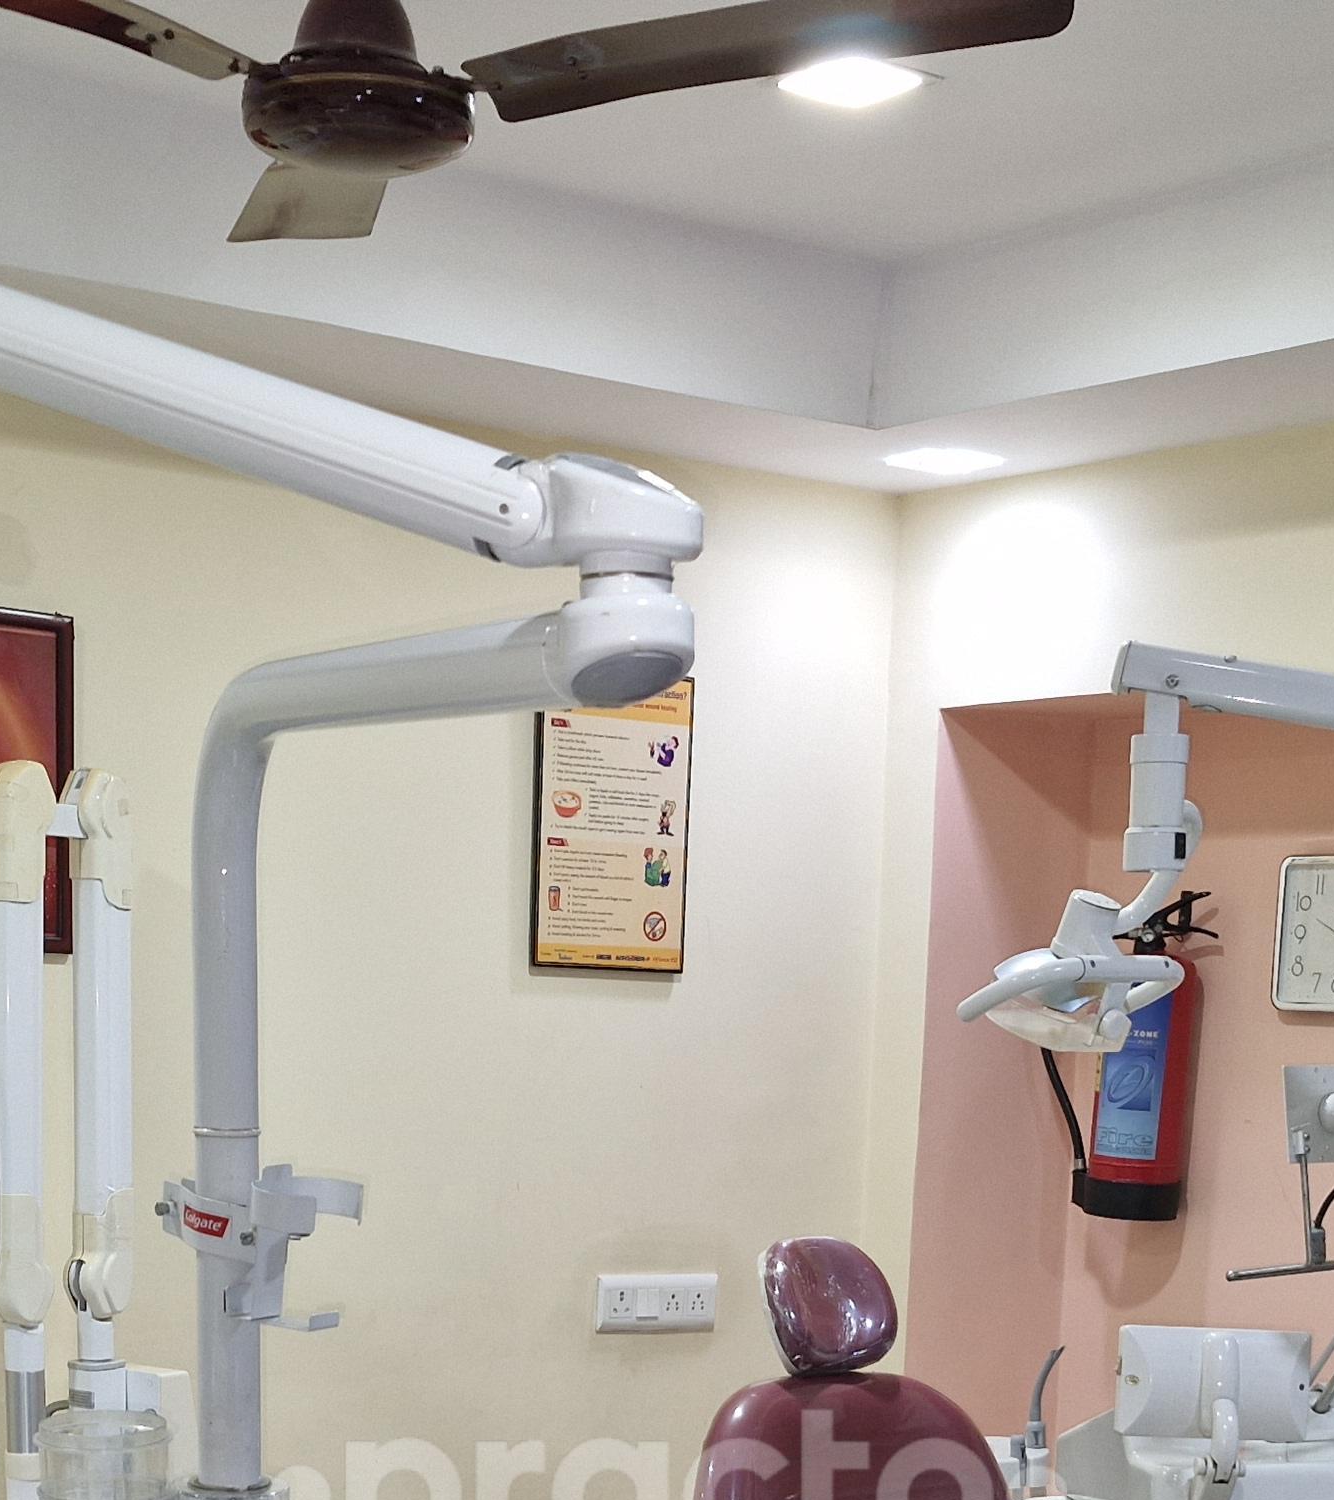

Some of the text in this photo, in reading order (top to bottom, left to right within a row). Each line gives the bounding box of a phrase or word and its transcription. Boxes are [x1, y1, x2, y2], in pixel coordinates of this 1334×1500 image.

[1295, 891, 1312, 912] 10
[1294, 924, 1307, 944] 9
[1291, 955, 1304, 977] 8
[1312, 972, 1322, 993] 7
[185, 1208, 224, 1232] Colgate
